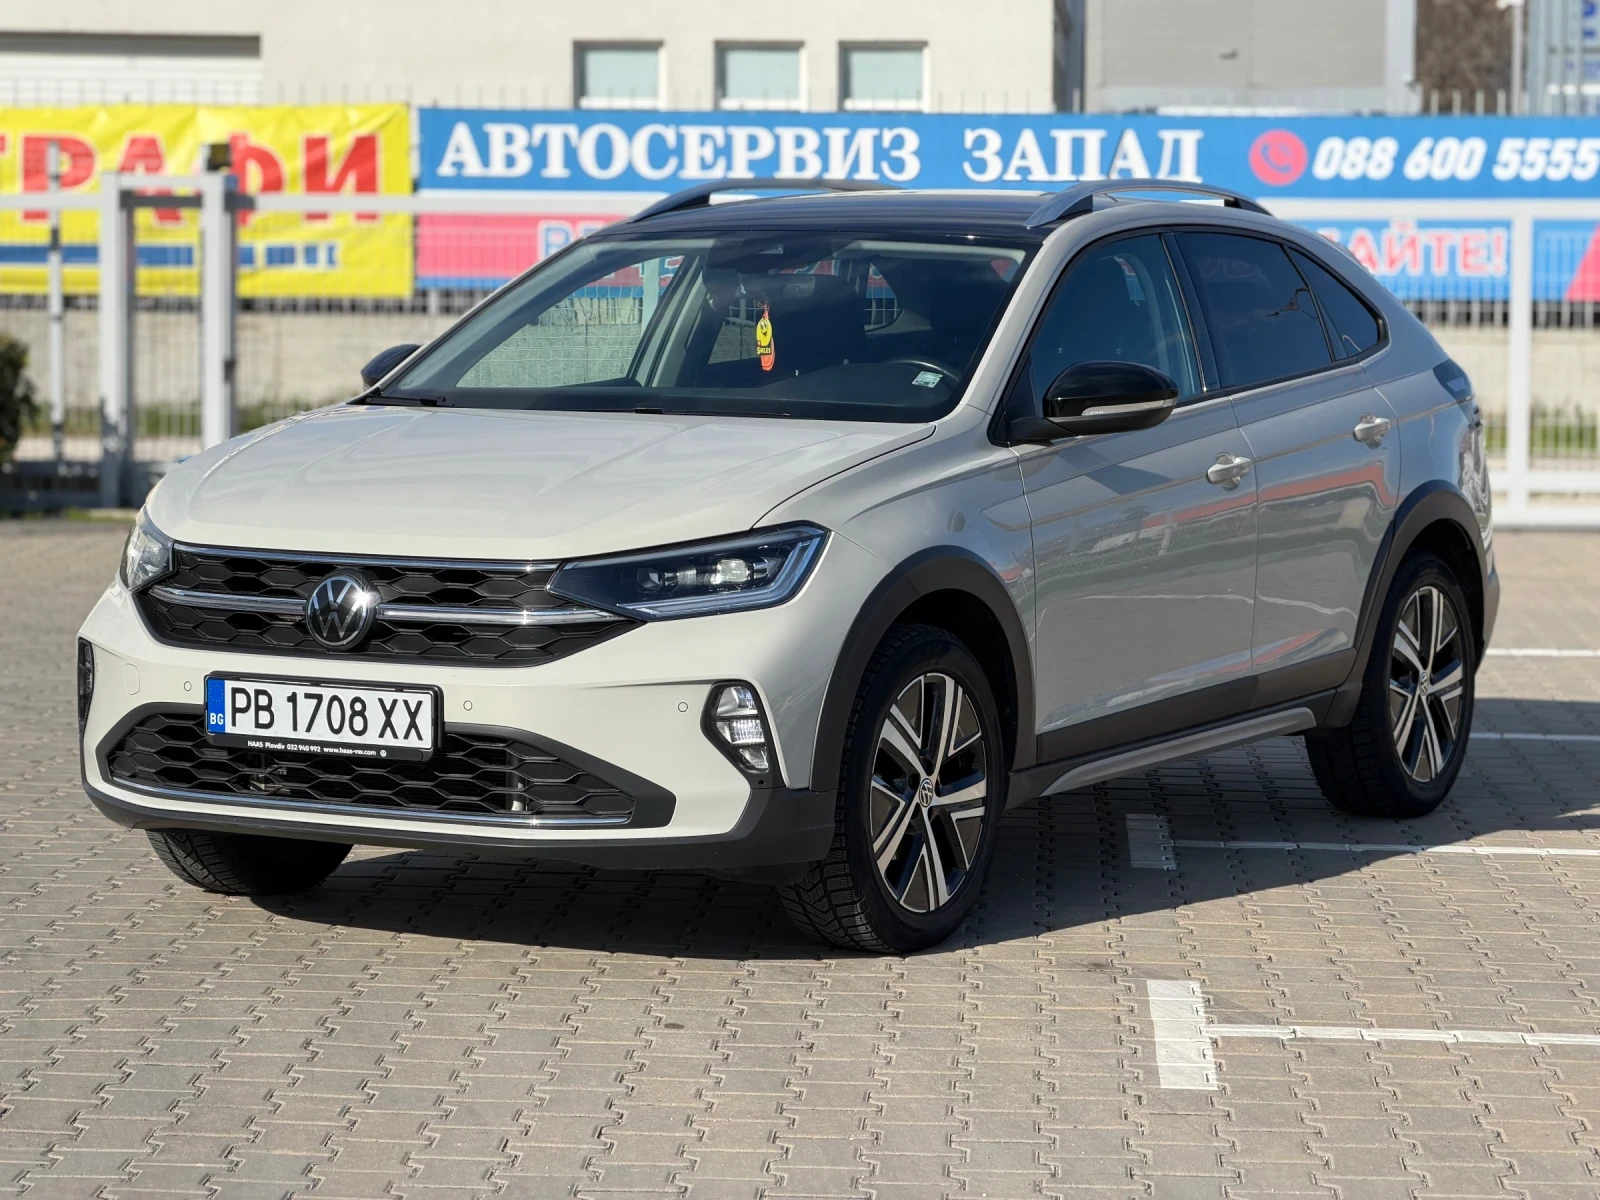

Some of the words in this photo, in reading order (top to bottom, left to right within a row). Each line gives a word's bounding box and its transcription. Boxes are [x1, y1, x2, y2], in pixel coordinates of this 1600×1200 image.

[436, 122, 921, 181] АВТОСЕРВИЗ
[963, 128, 1204, 183] ЗАПАД
[1312, 136, 1399, 181] 088
[1403, 136, 1487, 181] 600
[1492, 137, 1600, 181] 5555
[1318, 219, 1507, 277] АЙТЕ!
[209, 712, 224, 725] BG
[230, 687, 275, 729] PB
[286, 691, 369, 736] 1708
[377, 697, 424, 741] XX
[247, 740, 263, 748] HAAS
[265, 742, 285, 750] Plovdiv
